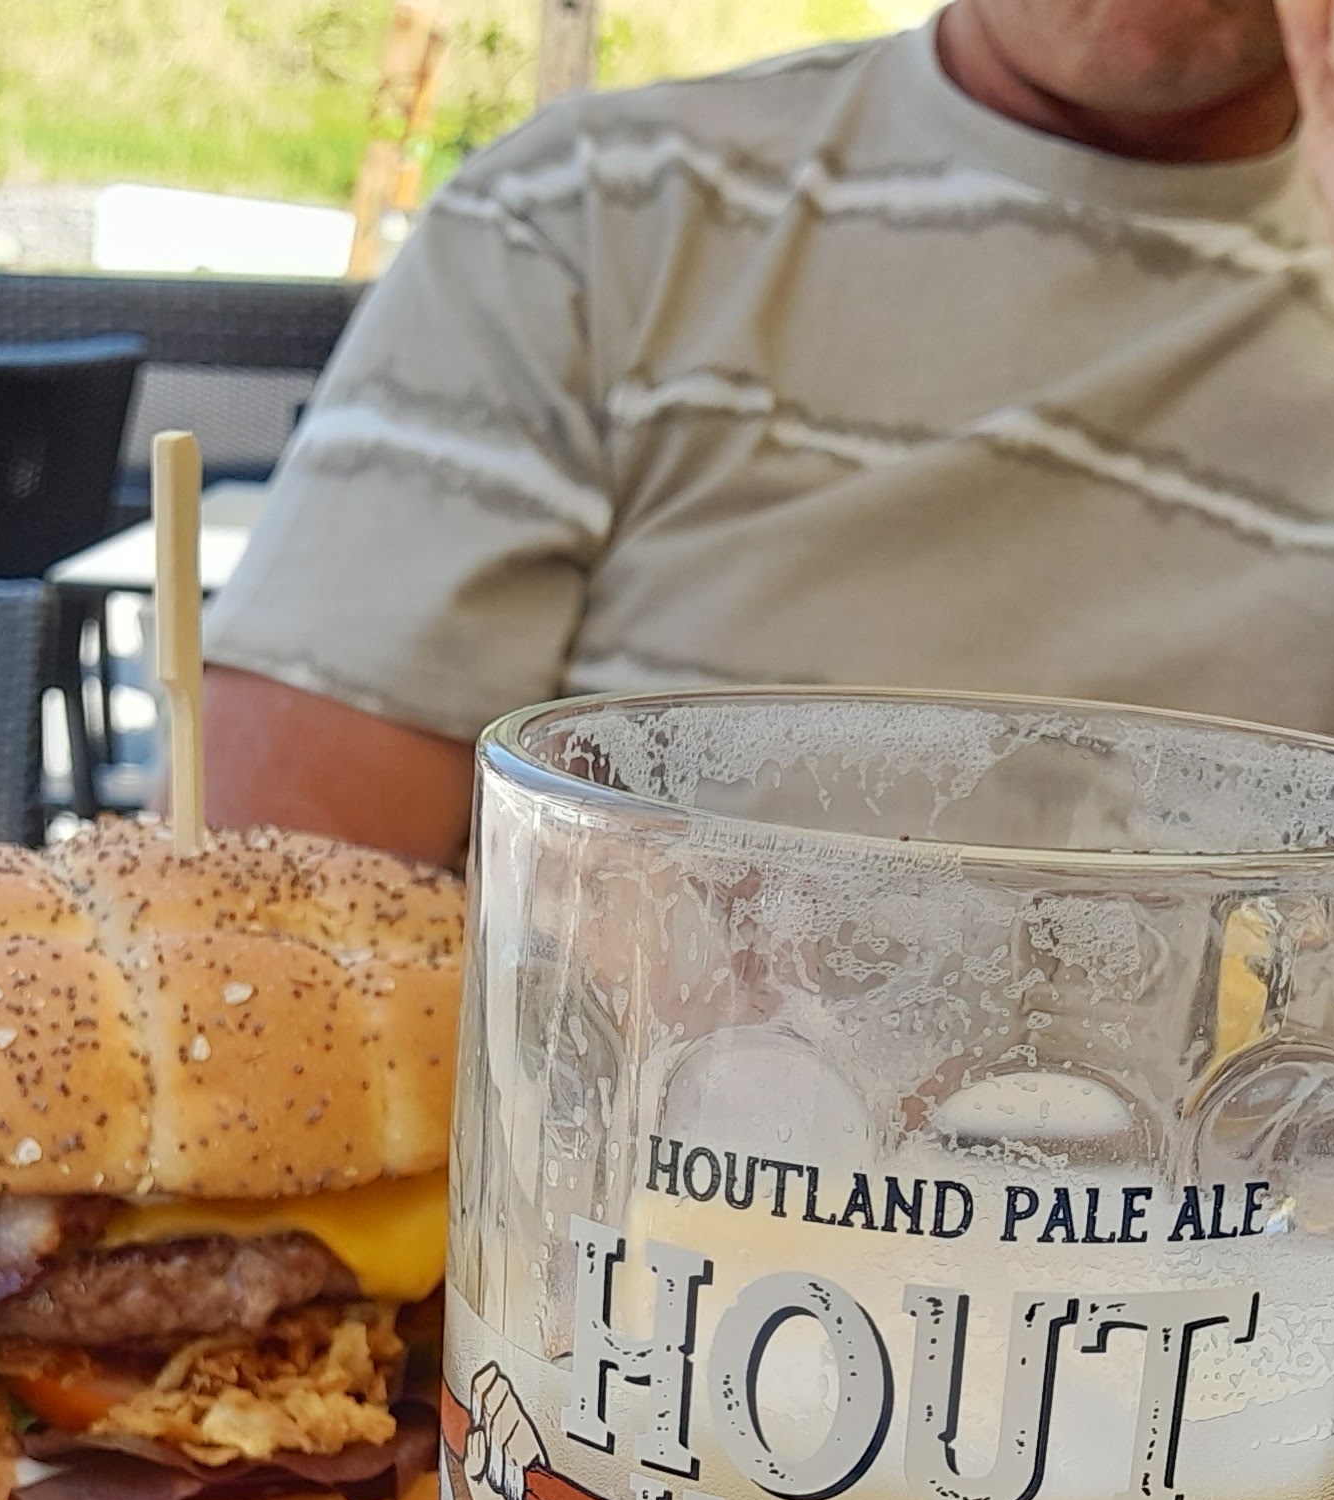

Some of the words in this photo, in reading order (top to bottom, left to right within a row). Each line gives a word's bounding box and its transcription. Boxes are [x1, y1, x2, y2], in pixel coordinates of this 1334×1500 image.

[646, 1134, 974, 1239] HOUTLAND
[999, 1185, 1153, 1244] PALE
[1167, 1181, 1270, 1242] ALE
